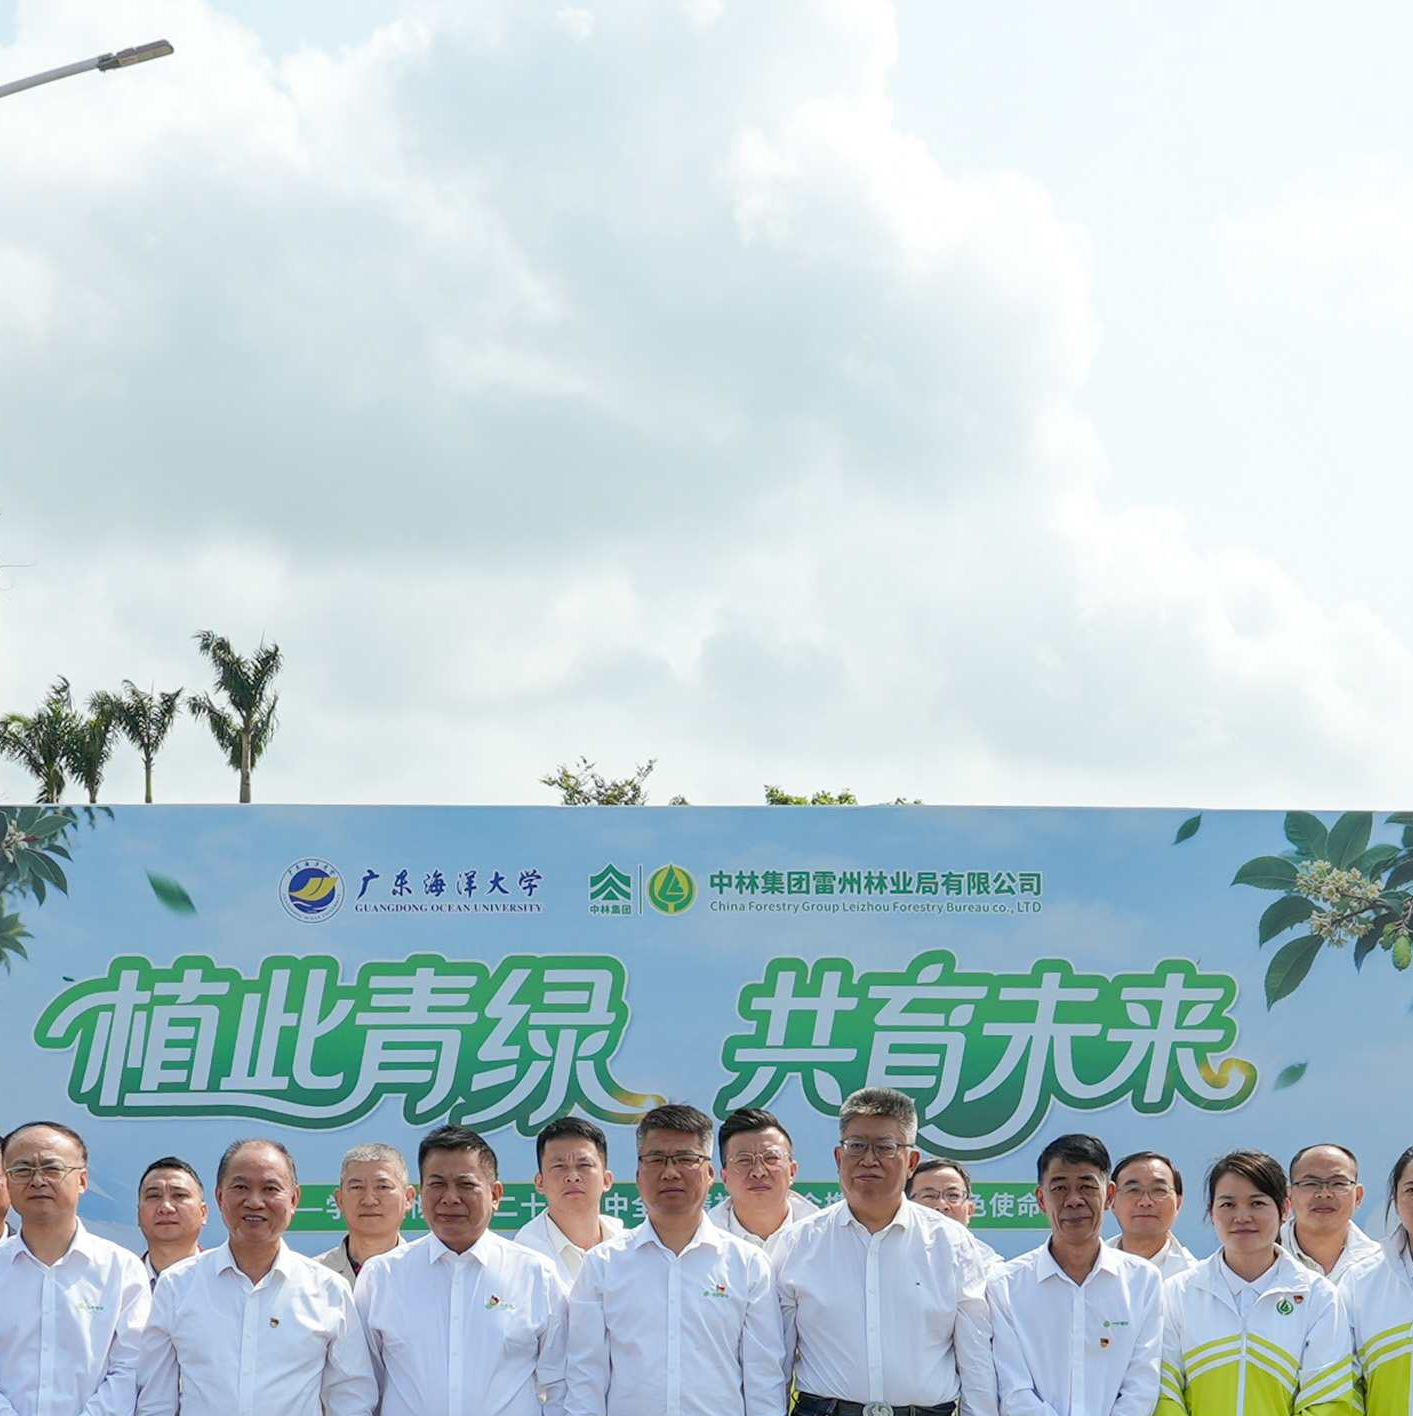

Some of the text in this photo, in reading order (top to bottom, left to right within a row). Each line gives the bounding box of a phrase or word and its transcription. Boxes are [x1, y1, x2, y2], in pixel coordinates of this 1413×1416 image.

[356, 868, 543, 900] 广东海洋大学
[709, 869, 1042, 896] 中林集团雷州林业局有限公司
[354, 903, 544, 913] GUANGDONG OCEAN UNIVERSITY
[589, 904, 632, 915] 中林集团
[710, 901, 746, 912] China
[748, 901, 799, 915] Forestry
[801, 902, 840, 915] Group
[842, 901, 890, 913] Leizhou
[892, 901, 944, 915] Forestry
[946, 902, 990, 913] Bureau
[1017, 901, 1042, 913] LTD
[46, 961, 1249, 1151] 植此青绿 共育未来
